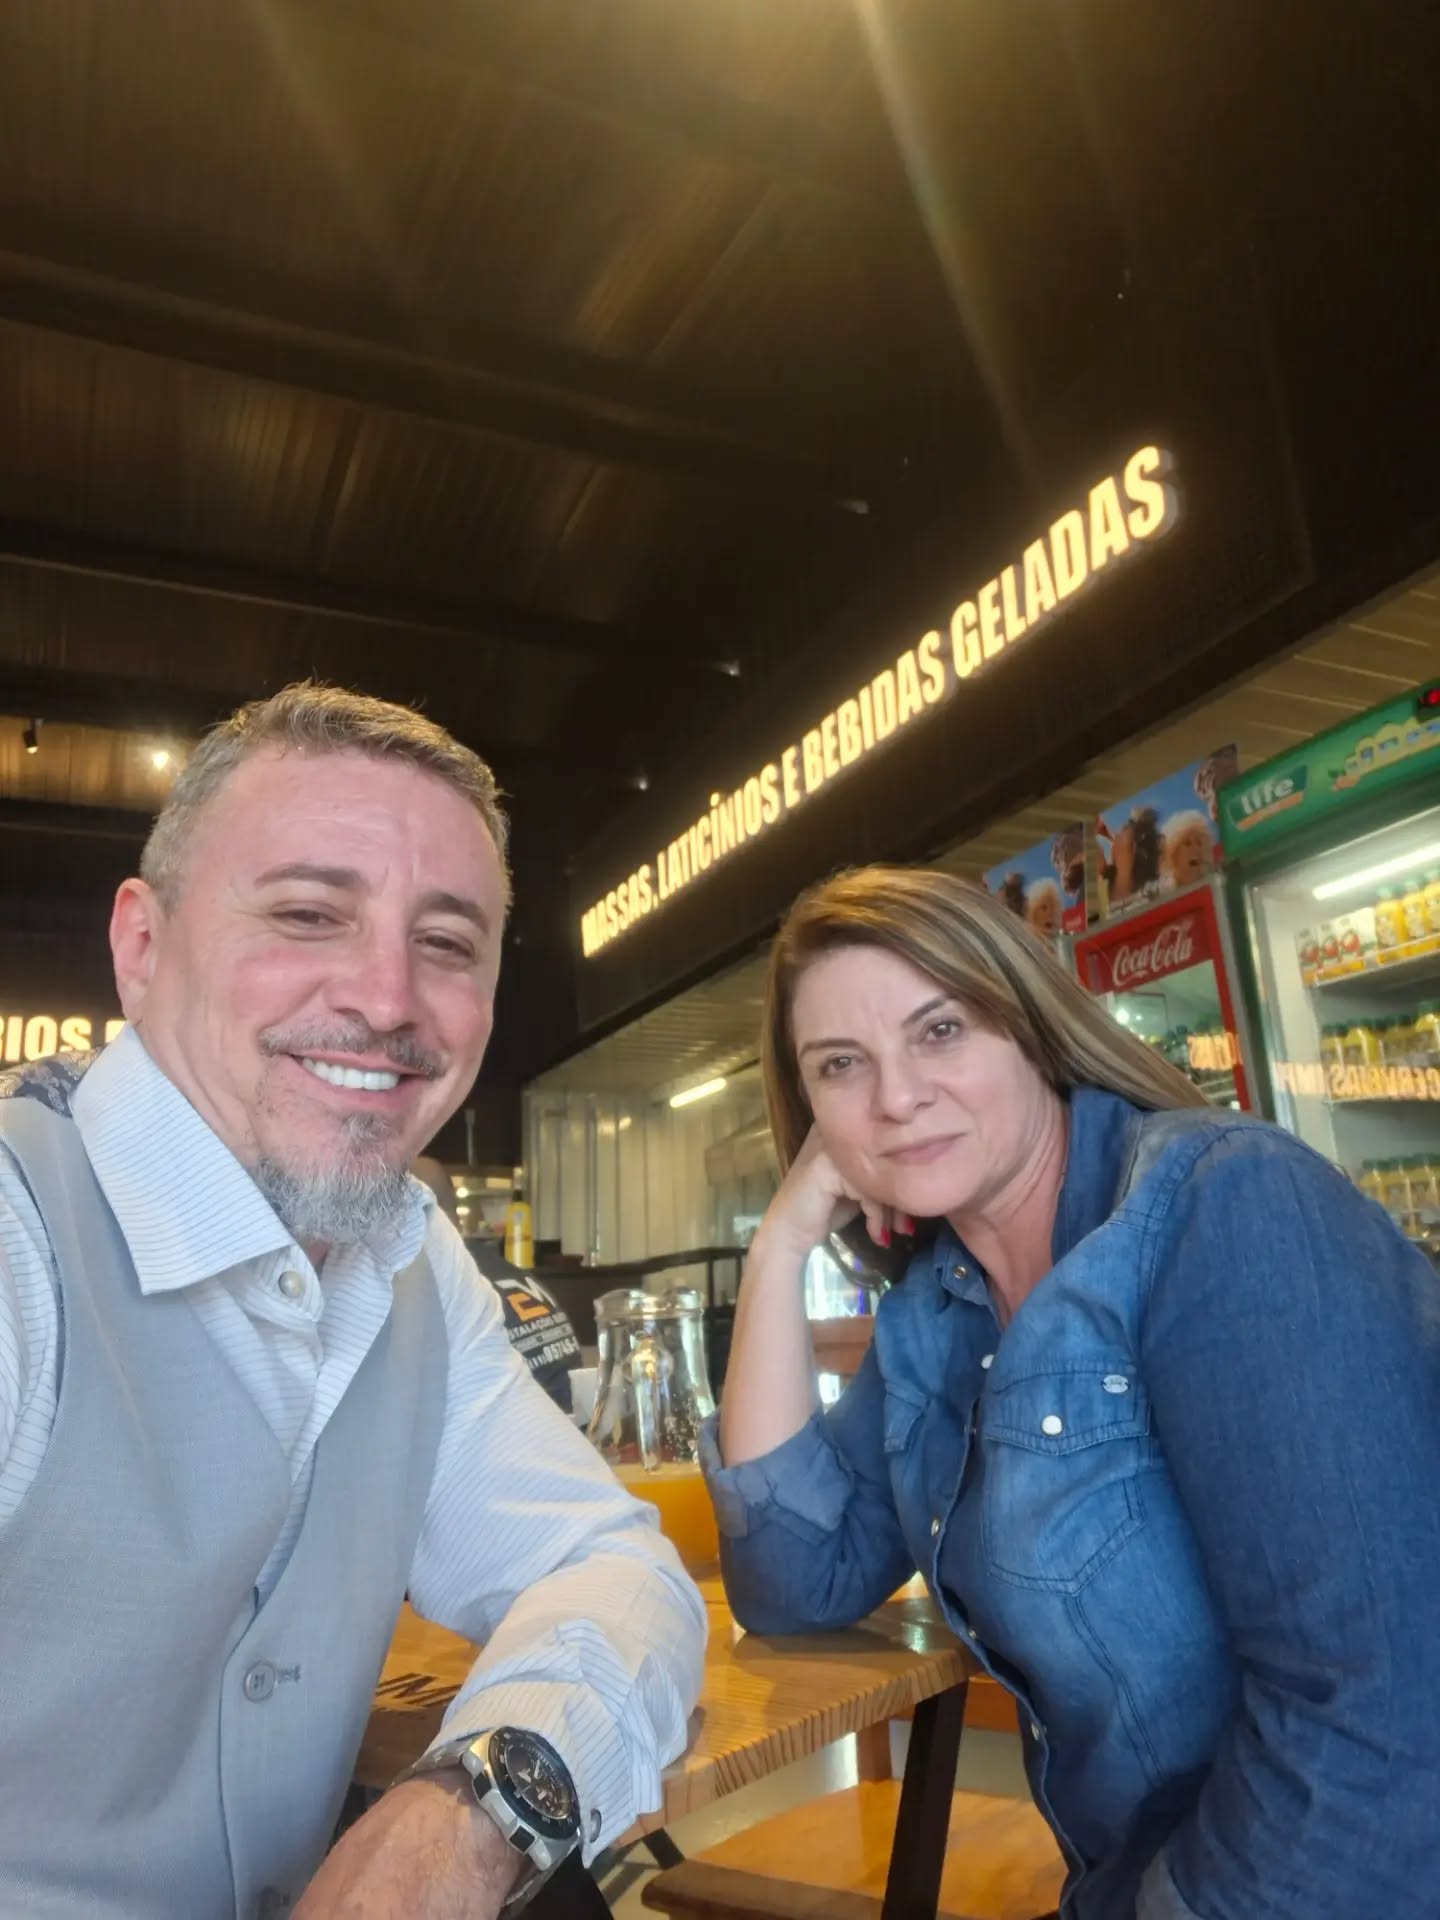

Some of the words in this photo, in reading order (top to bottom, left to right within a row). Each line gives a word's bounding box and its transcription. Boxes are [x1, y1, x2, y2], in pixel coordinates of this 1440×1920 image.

[581, 864, 658, 957] MASSAS,
[782, 745, 800, 808] E
[802, 629, 945, 794] BEBIDAS
[951, 446, 1166, 678] GELADAS
[0, 1015, 92, 1062] IOS
